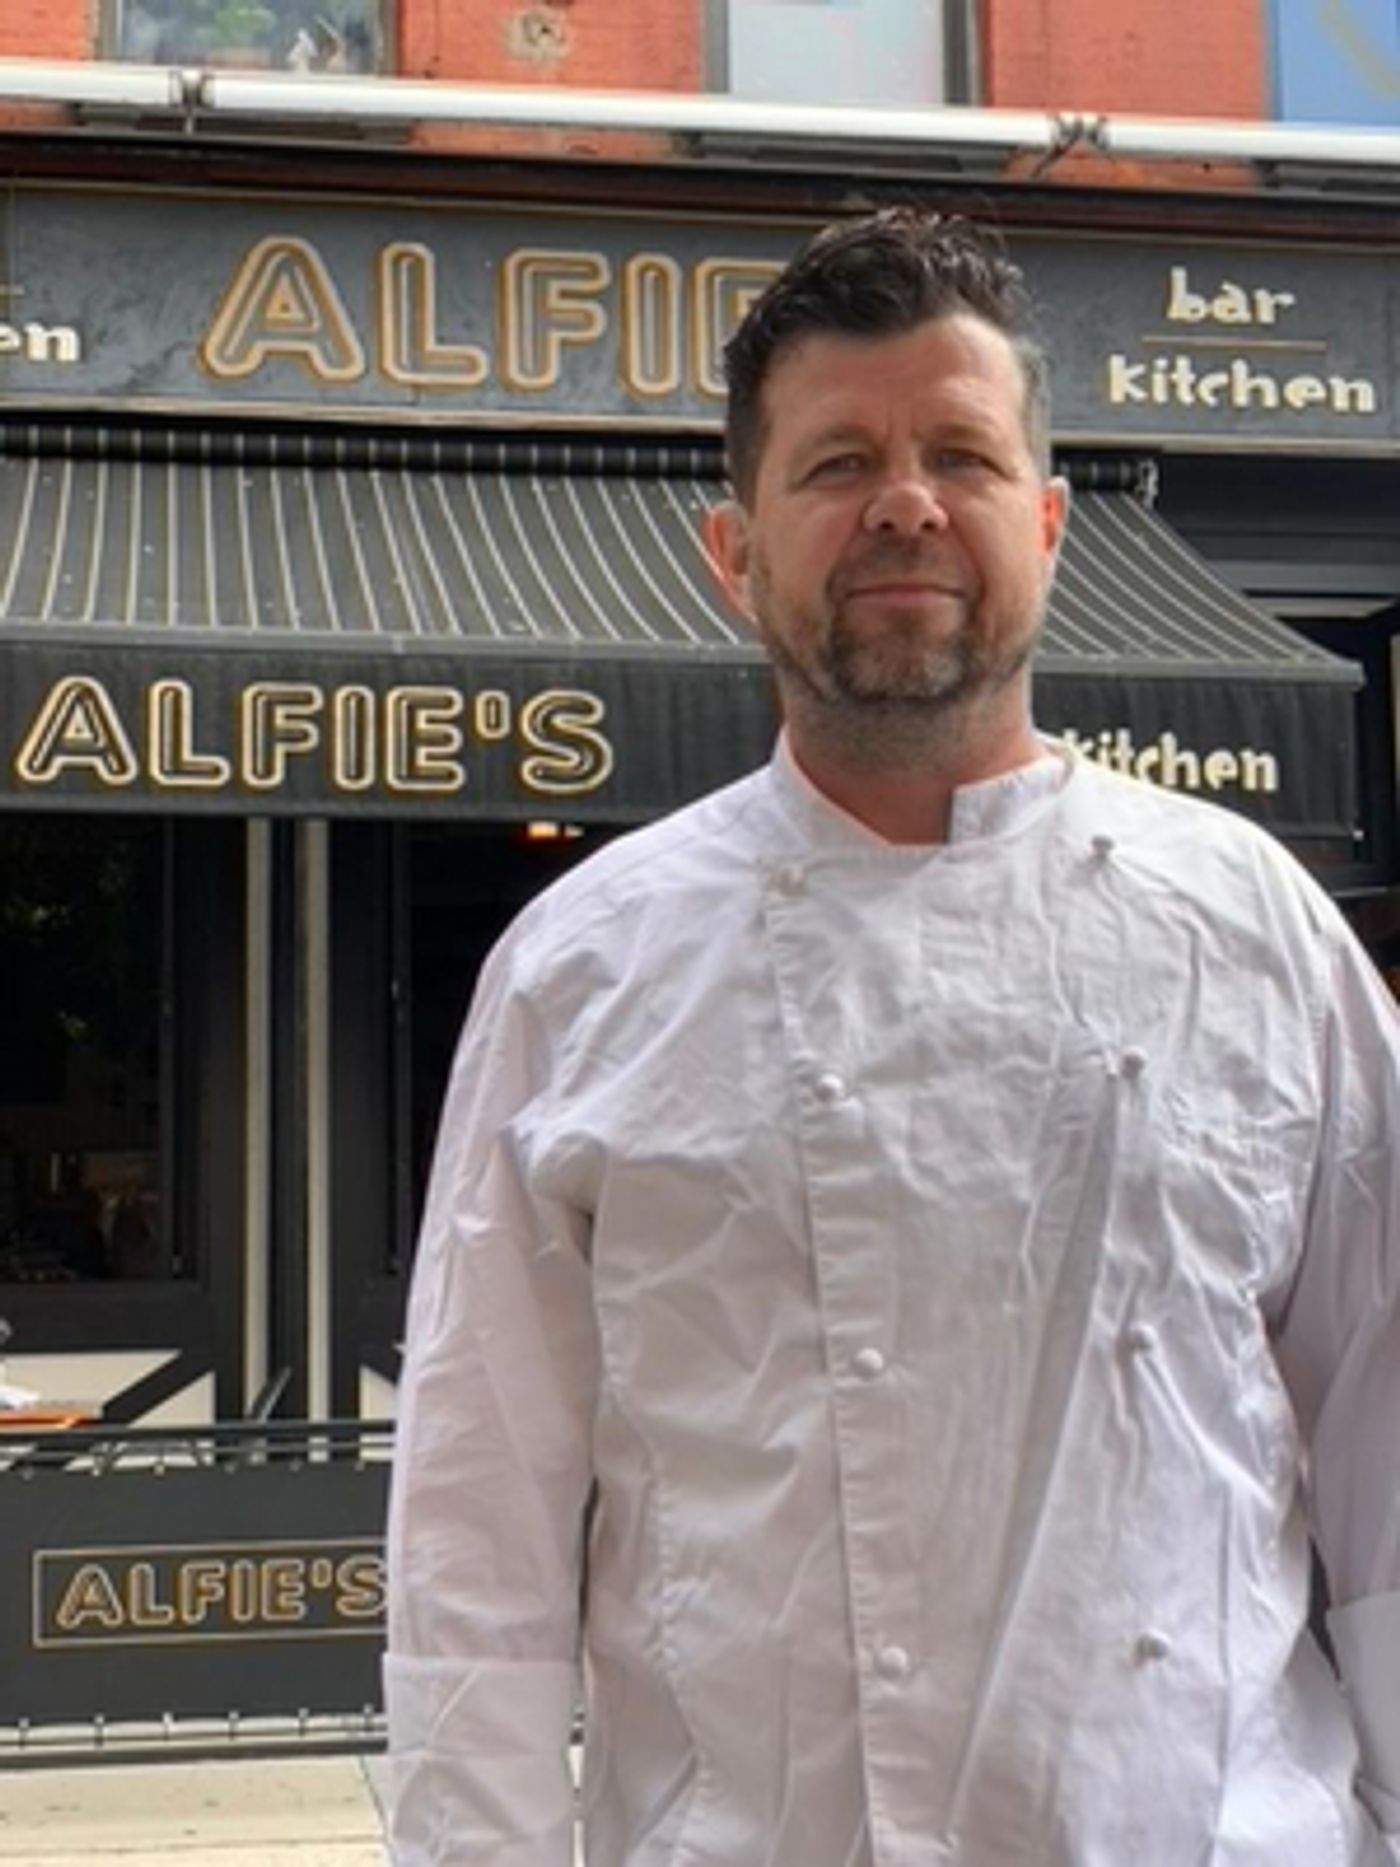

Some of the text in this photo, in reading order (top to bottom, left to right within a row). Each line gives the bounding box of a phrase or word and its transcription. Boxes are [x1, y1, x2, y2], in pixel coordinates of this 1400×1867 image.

[1167, 266, 1296, 324] bar
[1109, 354, 1376, 412] kitchen
[16, 676, 613, 791] ALFIE'S
[56, 1554, 388, 1629] ALFIE'S
